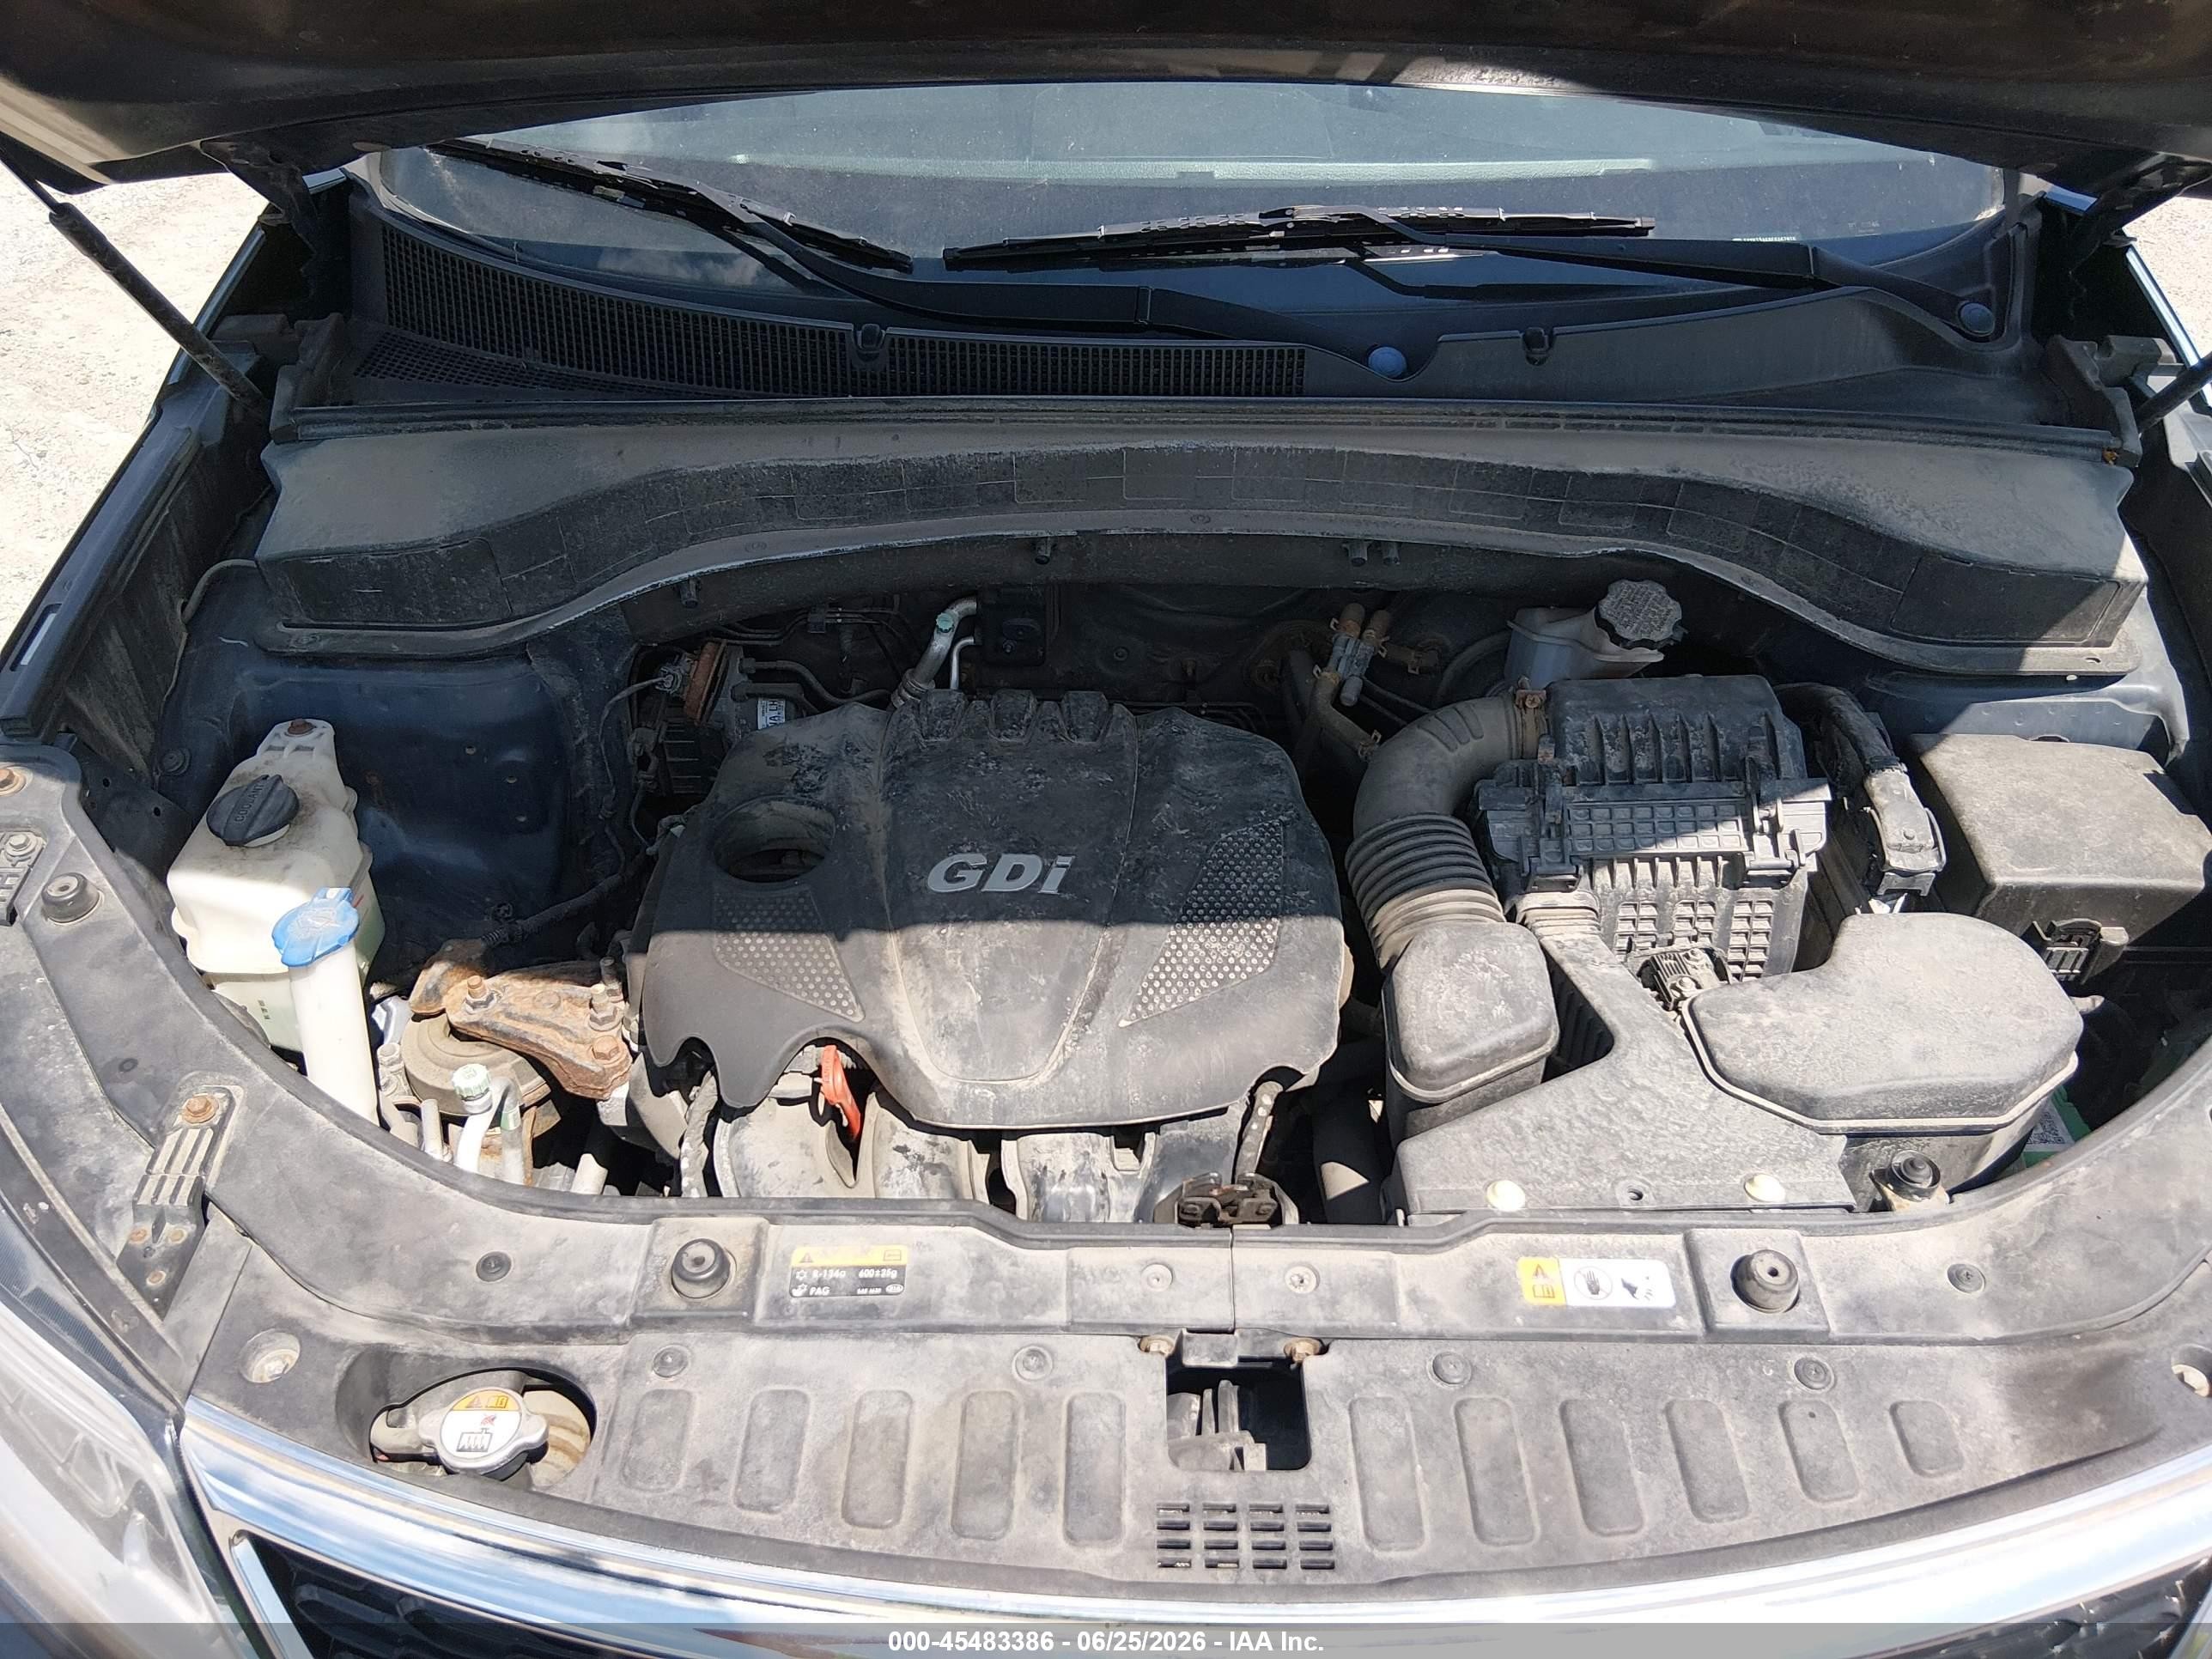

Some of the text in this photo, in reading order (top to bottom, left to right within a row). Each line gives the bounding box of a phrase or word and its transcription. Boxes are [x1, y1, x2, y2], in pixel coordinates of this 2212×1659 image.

[234, 784, 264, 823] COOLANT
[927, 853, 1075, 894] GDi
[811, 1269, 847, 1279] R-134a
[809, 1286, 830, 1296] PAG
